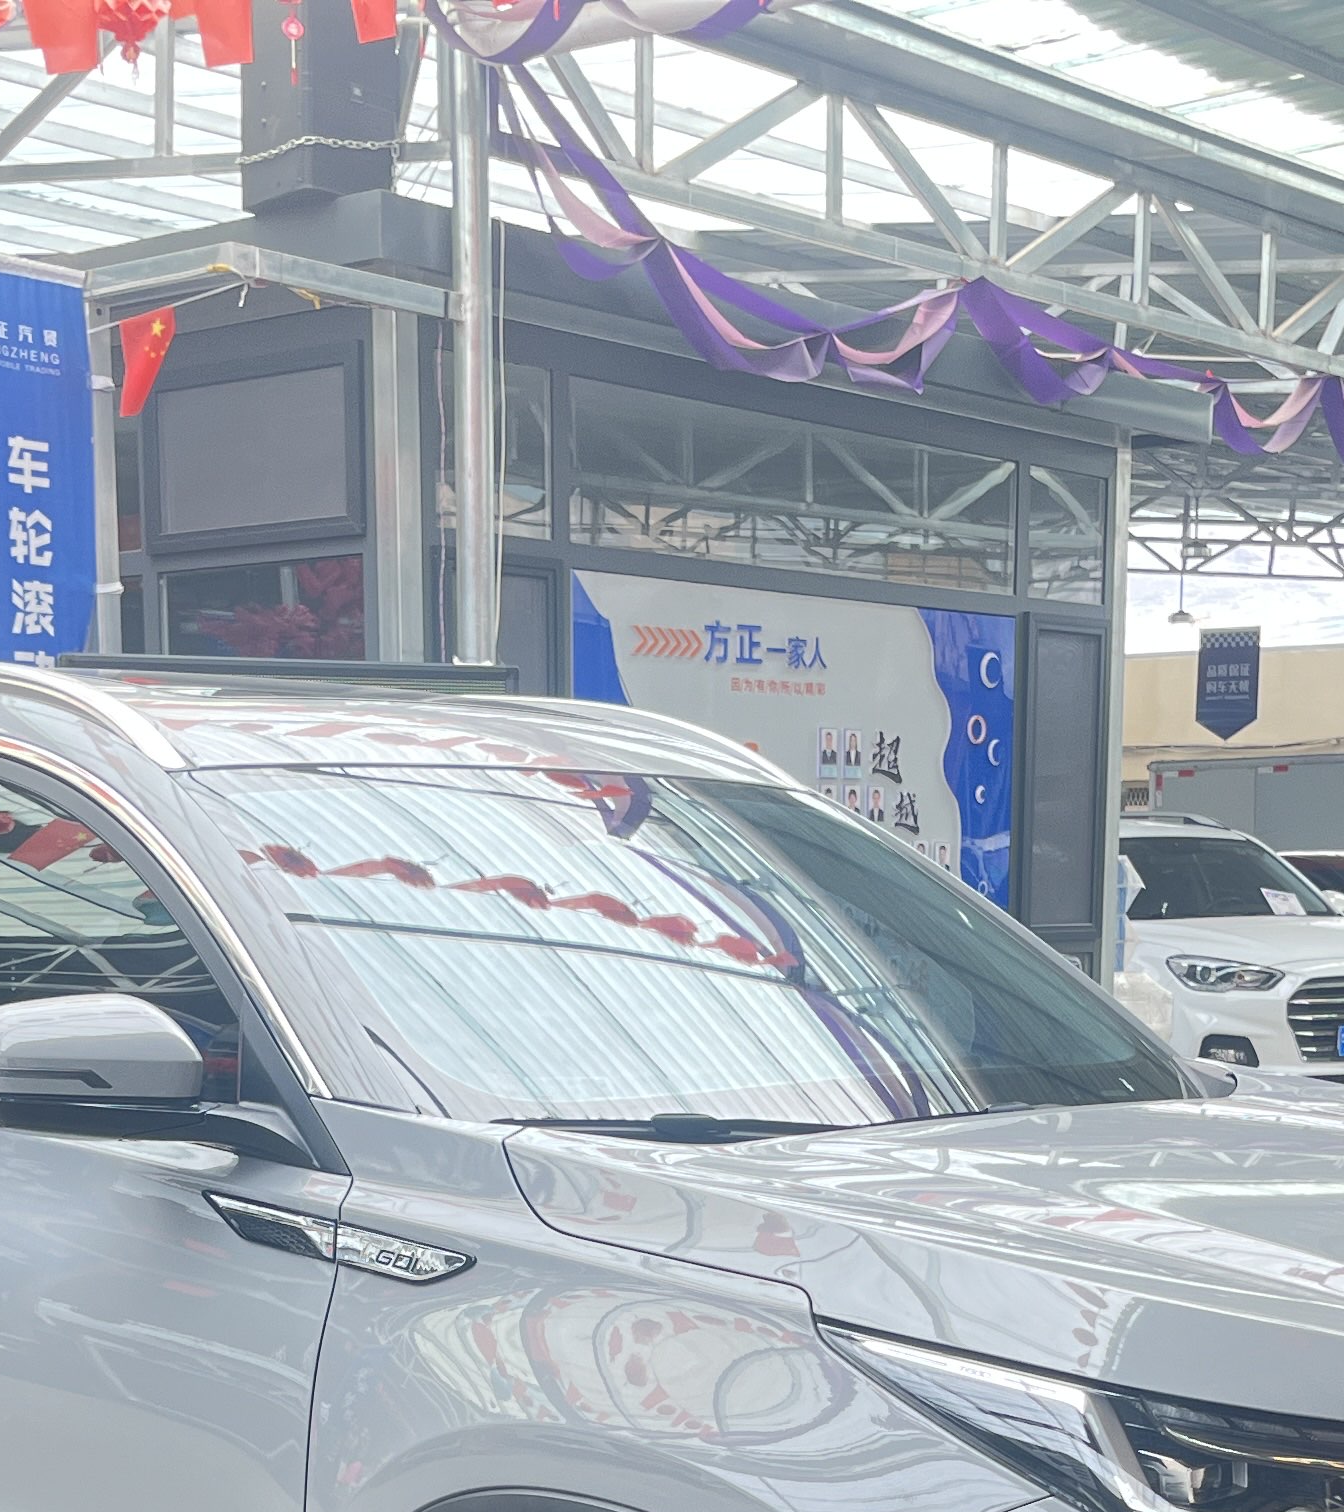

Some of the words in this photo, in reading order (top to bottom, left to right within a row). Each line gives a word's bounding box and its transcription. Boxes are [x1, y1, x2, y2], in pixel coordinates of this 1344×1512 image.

[704, 619, 828, 670] 方正一家人
